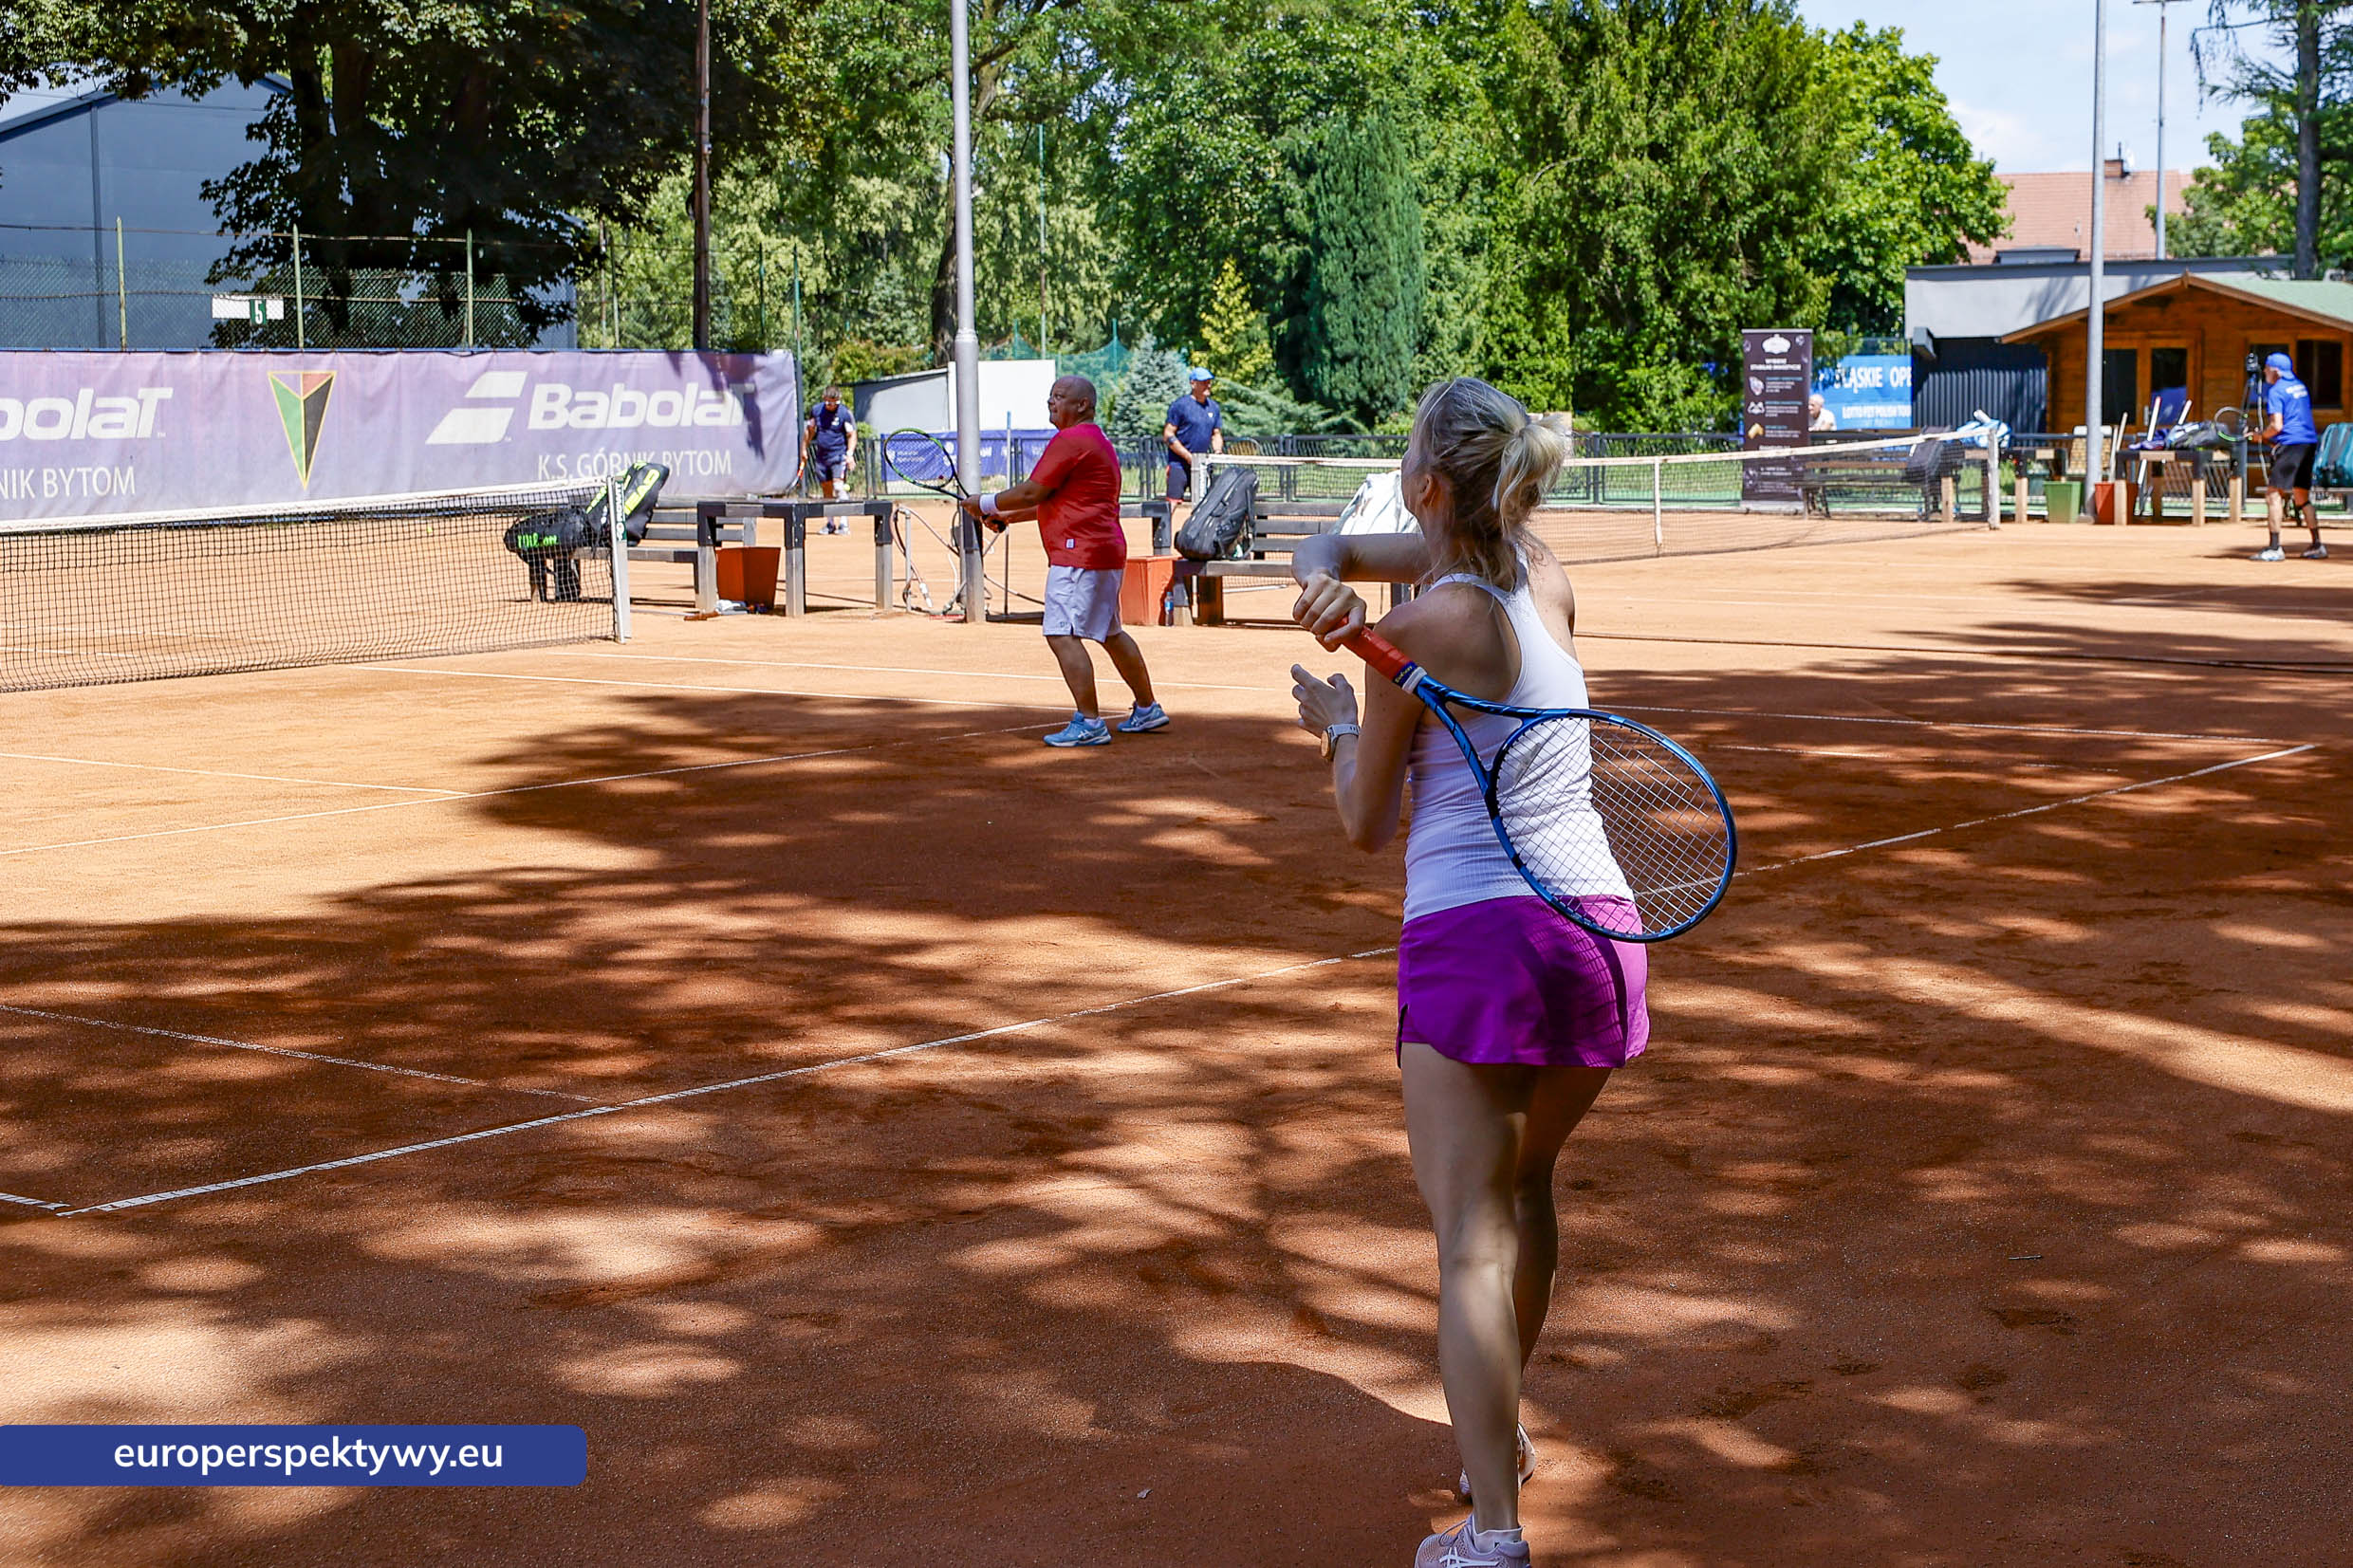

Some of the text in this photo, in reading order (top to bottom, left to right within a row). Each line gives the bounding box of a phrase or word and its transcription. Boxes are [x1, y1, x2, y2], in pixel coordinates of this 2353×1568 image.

[254, 300, 264, 324] 5
[43, 466, 136, 498] BYTOM
[517, 532, 560, 549] Wilon
